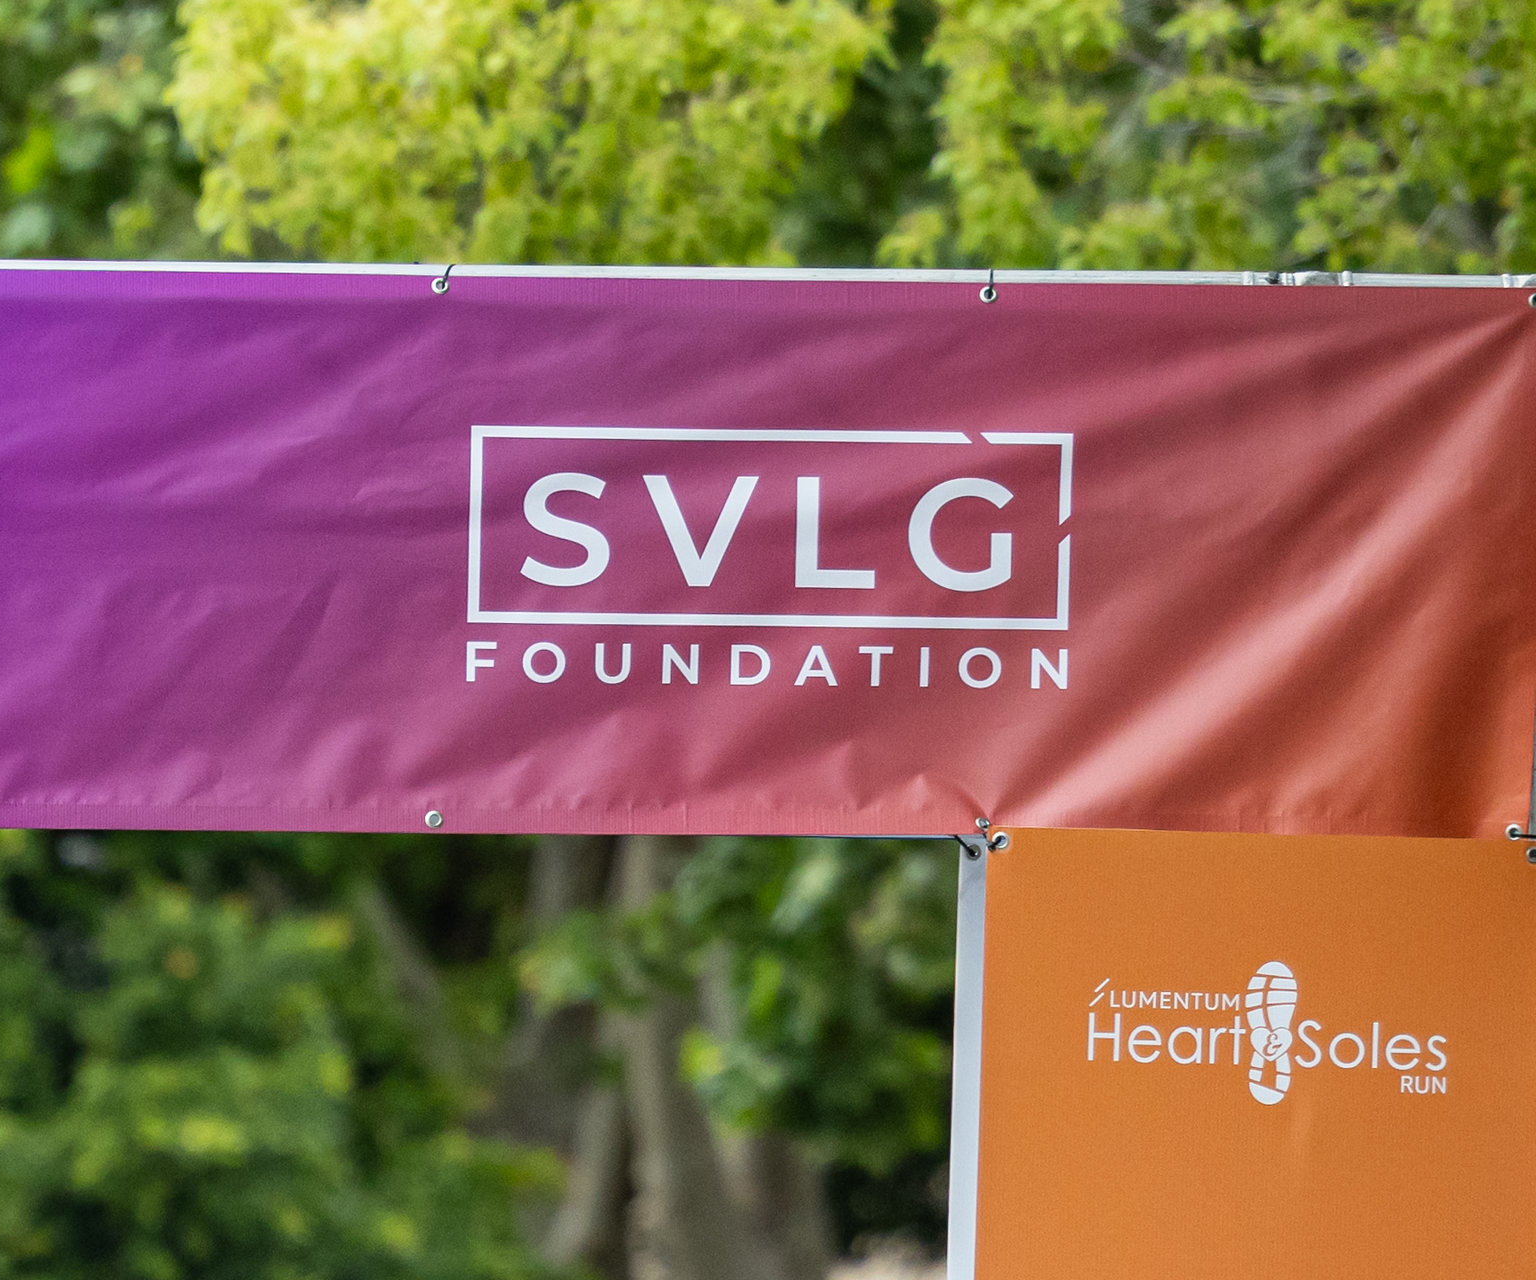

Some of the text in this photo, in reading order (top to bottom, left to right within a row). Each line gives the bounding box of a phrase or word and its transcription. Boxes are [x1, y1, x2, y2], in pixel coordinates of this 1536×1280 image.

[522, 474, 1014, 592] SVLG
[467, 642, 1069, 690] FOUNDATION
[1111, 992, 1240, 1011] LUMENTUM
[1089, 1013, 1245, 1065] Heart
[1296, 1021, 1447, 1072] Soles
[1402, 1077, 1447, 1094] RUN
